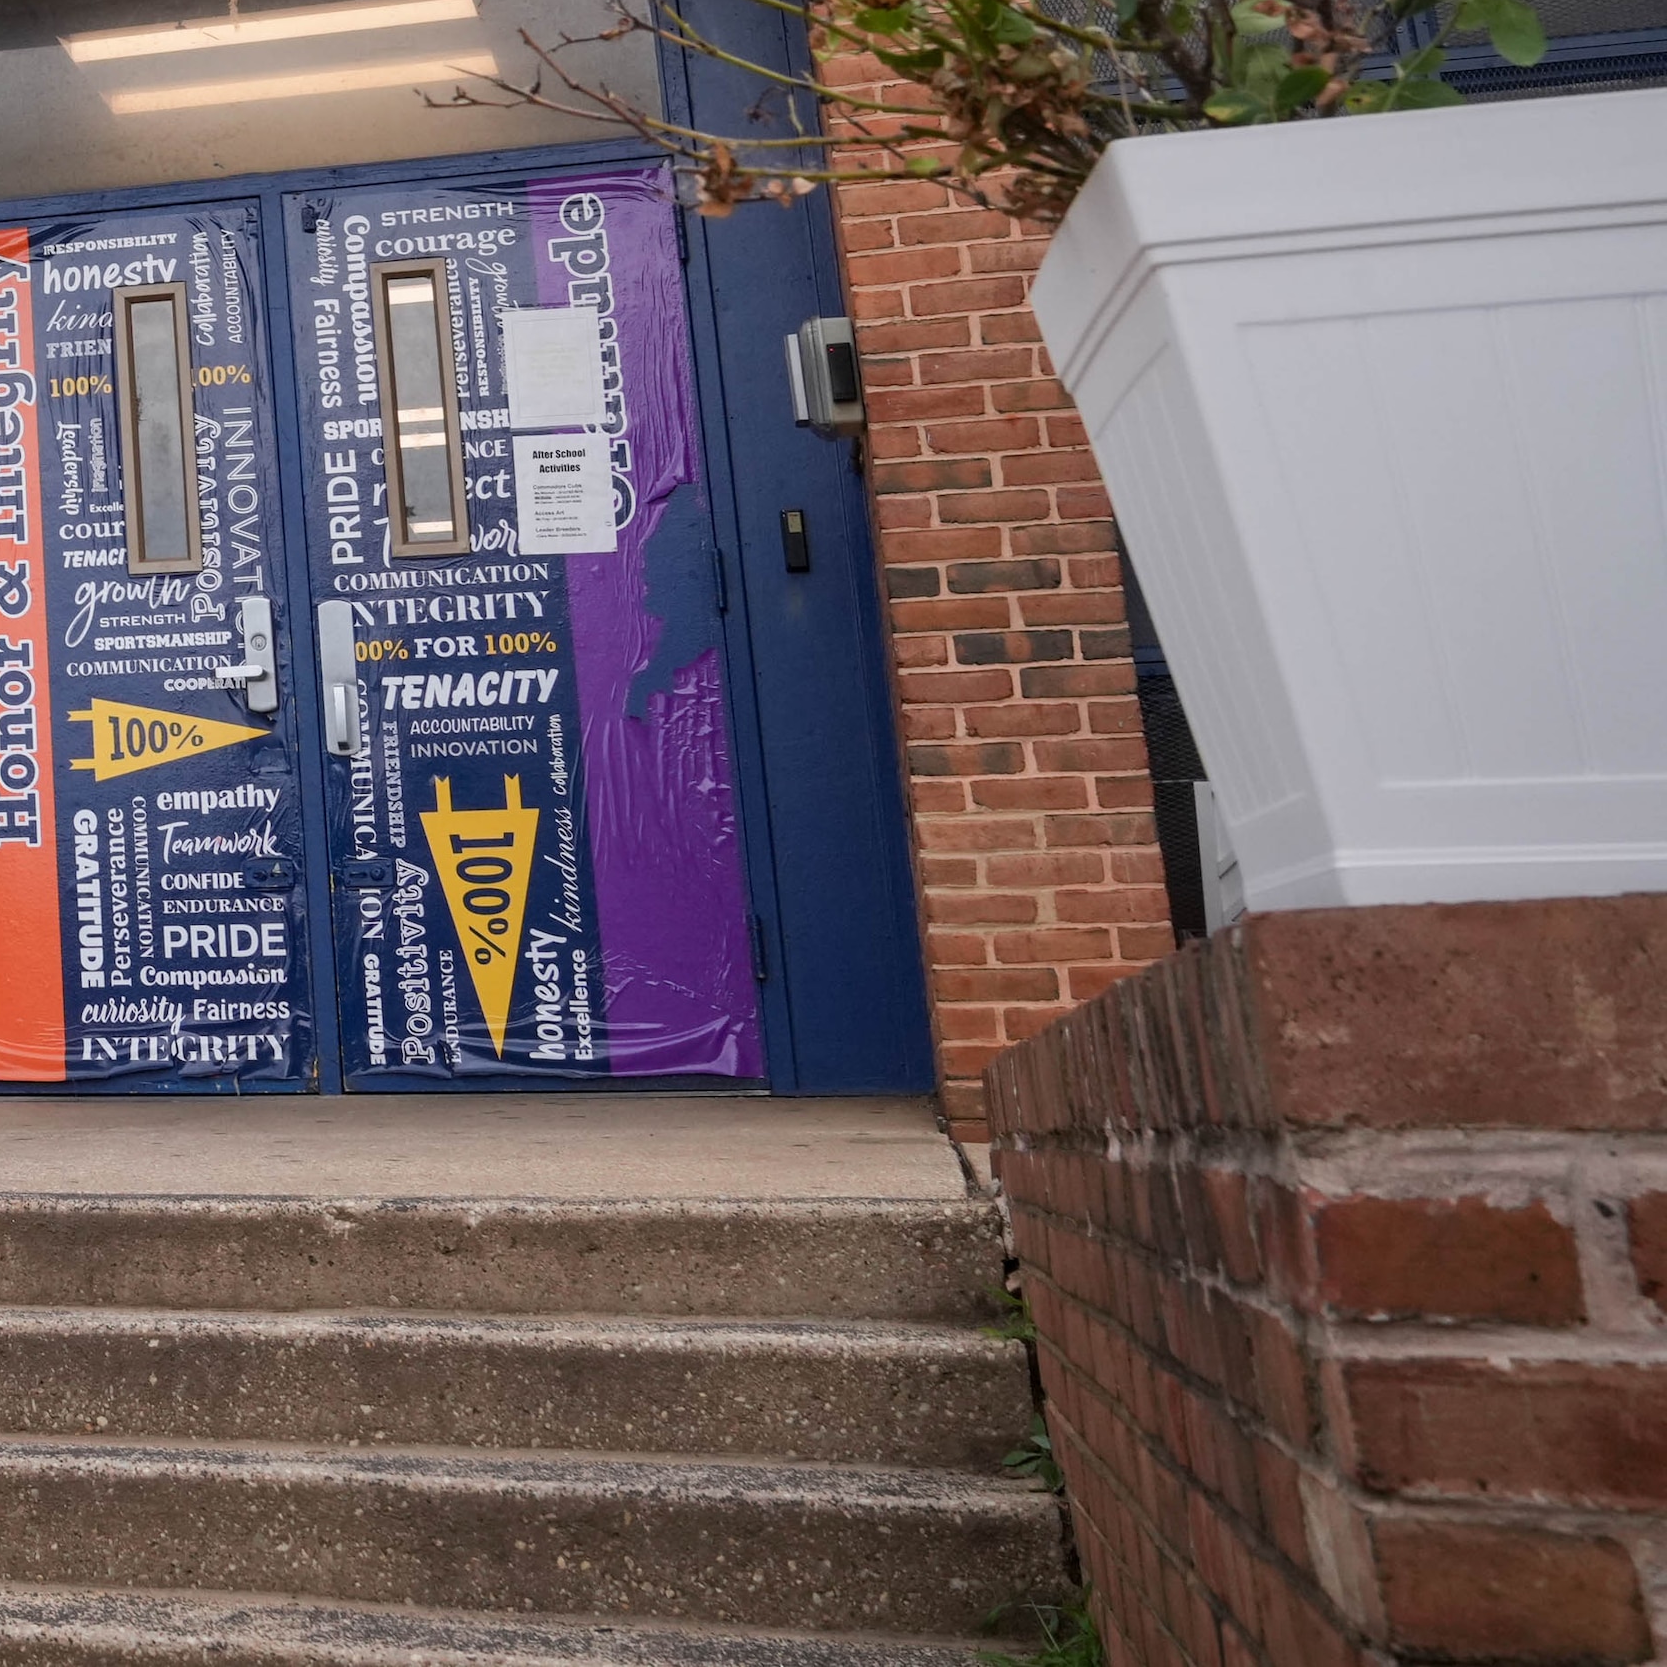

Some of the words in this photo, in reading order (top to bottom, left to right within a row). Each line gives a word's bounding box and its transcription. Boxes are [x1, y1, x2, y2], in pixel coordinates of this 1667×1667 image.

[381, 201, 514, 227] STRENGTH
[43, 234, 177, 255] RESPONSIBILITY
[309, 219, 332, 286] curiosity
[375, 224, 517, 257] courage
[43, 253, 177, 295] honesty
[188, 232, 214, 346] Collaboration
[220, 229, 243, 344] ACCOUNTABILITY
[343, 215, 377, 406] Compassion
[314, 298, 341, 409] Fairness
[468, 277, 489, 397] RESPONSIBILITY
[49, 375, 112, 398] 100%
[55, 422, 82, 516] Leadership
[533, 451, 553, 459] After
[556, 449, 585, 458] School
[540, 464, 581, 473] Activities
[325, 449, 364, 565] PRIDE
[333, 563, 549, 592] COMMUNICATION
[94, 631, 232, 651] SPORTSMANSHIP
[99, 612, 185, 628] STRENGTH
[67, 655, 231, 676] COMMUNICATION
[414, 636, 478, 659] FOR
[485, 632, 557, 655] 100%
[381, 669, 559, 711] TENACITY
[108, 716, 204, 761] 100%
[410, 716, 535, 735] ACCOUNTABILITY
[410, 739, 538, 758] INNOVATION
[552, 713, 569, 796] Collaboration
[157, 784, 280, 814] empathy
[383, 720, 406, 848] FRIENDSHIP
[162, 820, 282, 864] Teamwork
[132, 796, 154, 959] COMMUNICATION
[549, 805, 583, 933] kindness
[74, 809, 106, 988] GRATITUDE
[108, 808, 132, 987] Perseverance
[162, 898, 284, 914] ENDURANCE
[451, 832, 514, 965] 100%
[162, 923, 287, 958] PRIDE
[396, 858, 434, 1066] Positivity
[140, 964, 287, 990] Compassion
[525, 929, 568, 1060] honesty
[82, 997, 185, 1034] curiosity
[193, 1001, 290, 1021] Fairness
[364, 953, 386, 1066] GRATITUDE
[440, 948, 461, 1065] ENDURANCE
[574, 948, 593, 1061] Excellence
[82, 1034, 290, 1063] INTEGRITY
